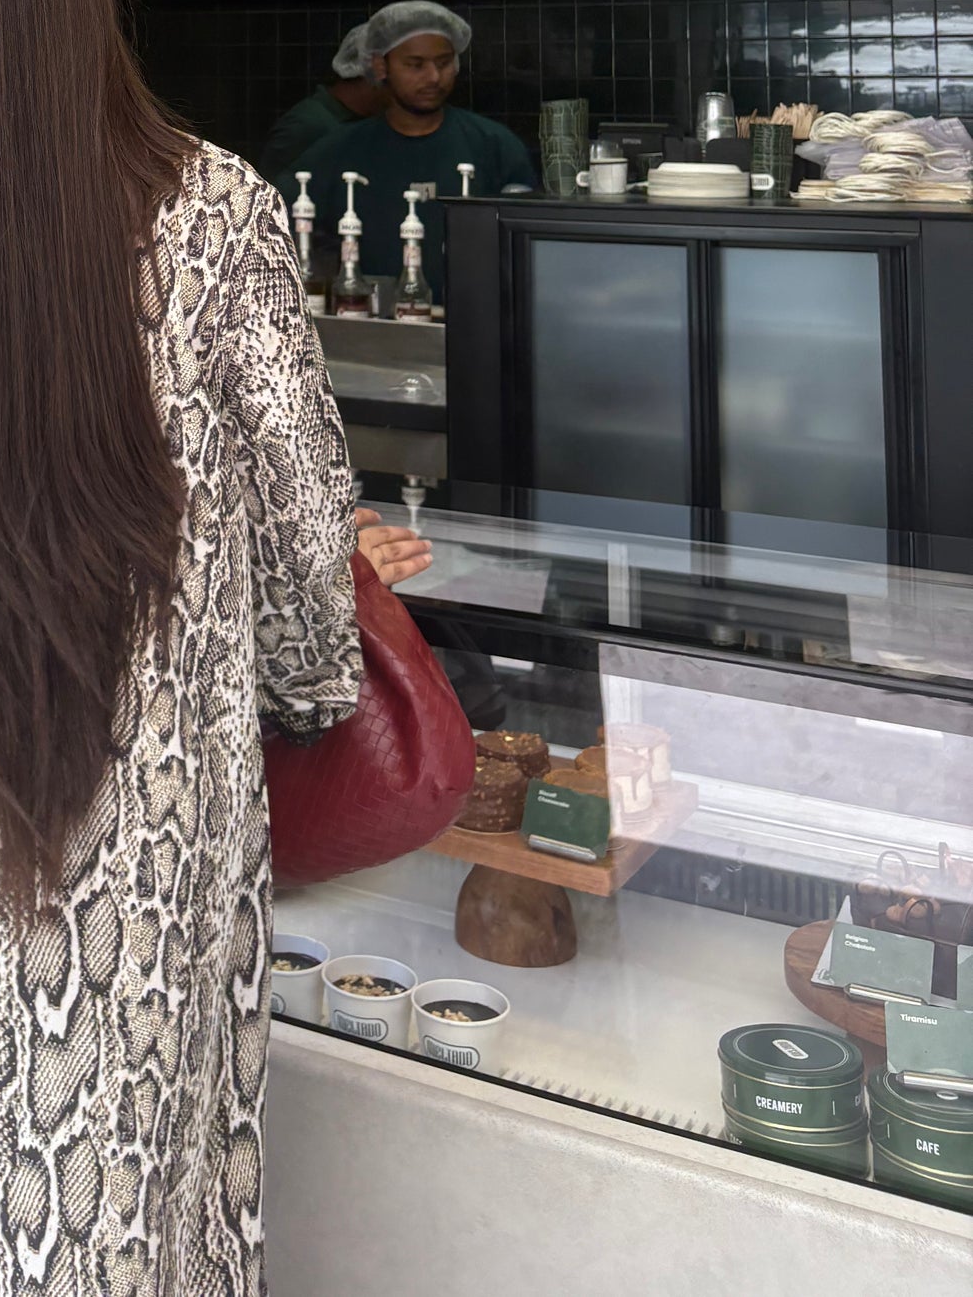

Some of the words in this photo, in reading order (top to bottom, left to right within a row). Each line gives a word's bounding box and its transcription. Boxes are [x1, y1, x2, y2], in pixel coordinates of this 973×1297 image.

[900, 1013, 938, 1025] Tiramisu
[755, 1095, 803, 1114] CREAMERY
[915, 1138, 941, 1156] CAFE
